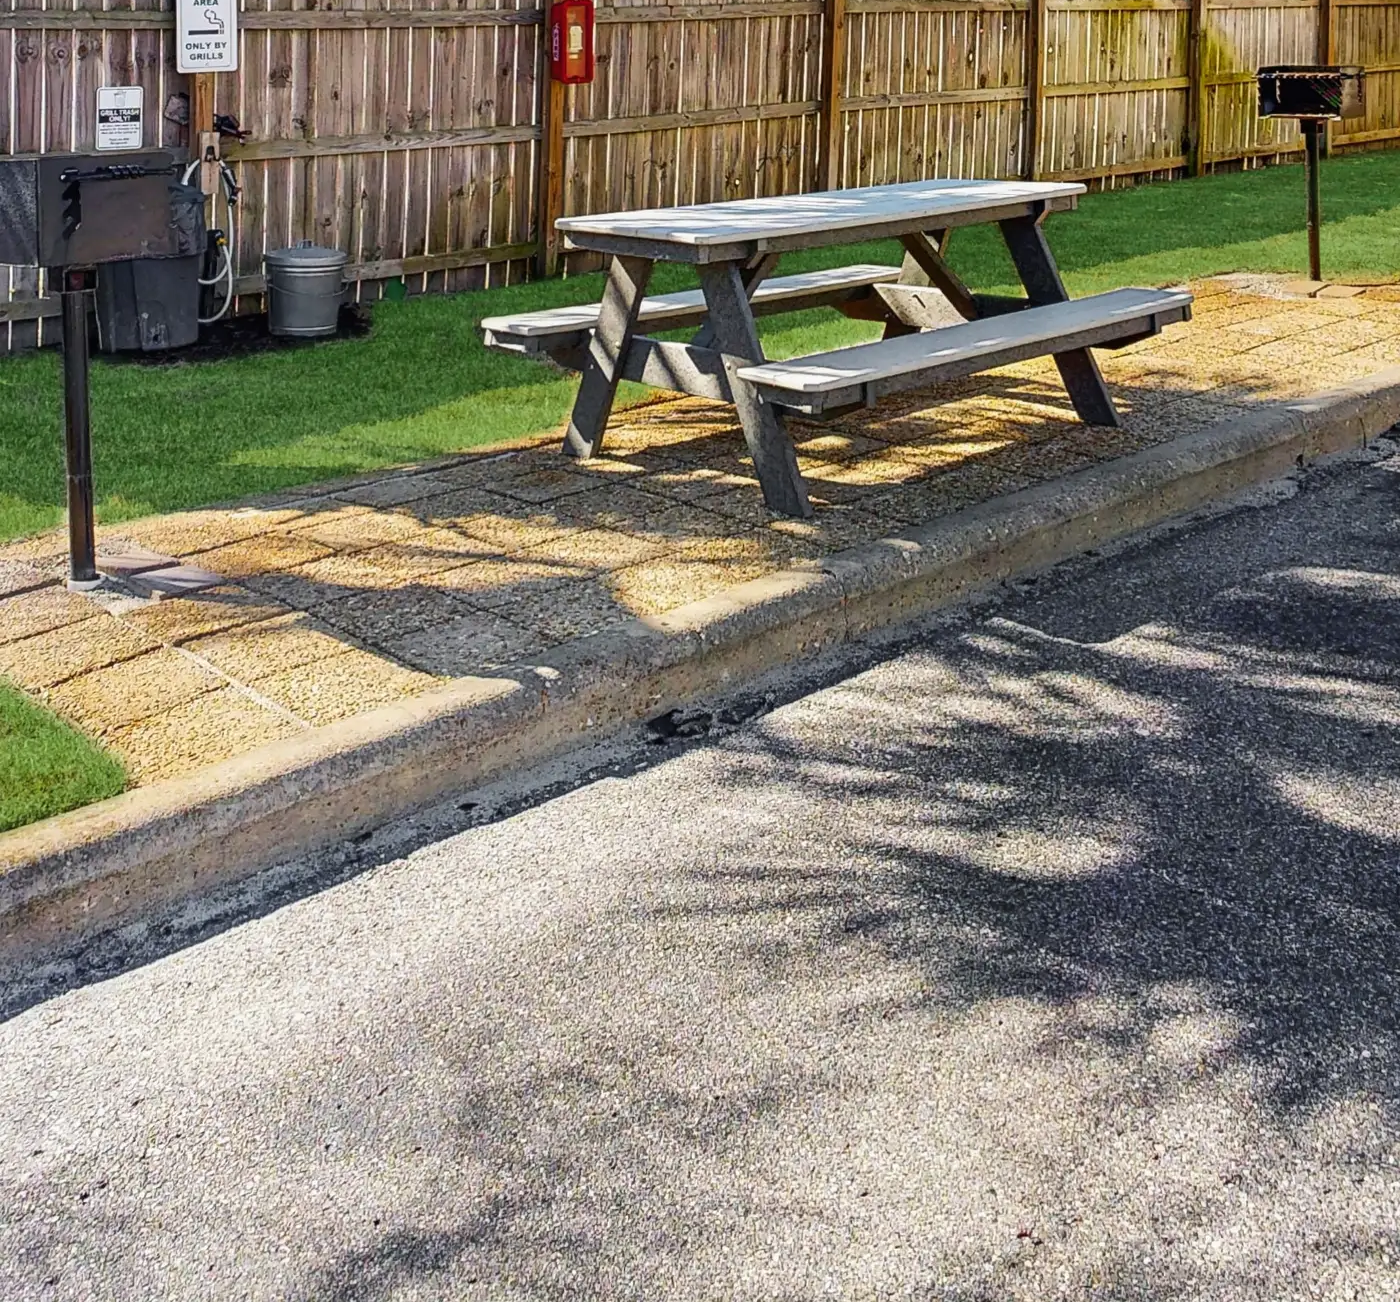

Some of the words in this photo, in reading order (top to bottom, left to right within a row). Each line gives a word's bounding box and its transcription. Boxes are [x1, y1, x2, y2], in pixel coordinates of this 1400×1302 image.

[185, 42, 212, 50] ONLY
[214, 41, 227, 49] BY
[189, 52, 224, 61] GRILLS
